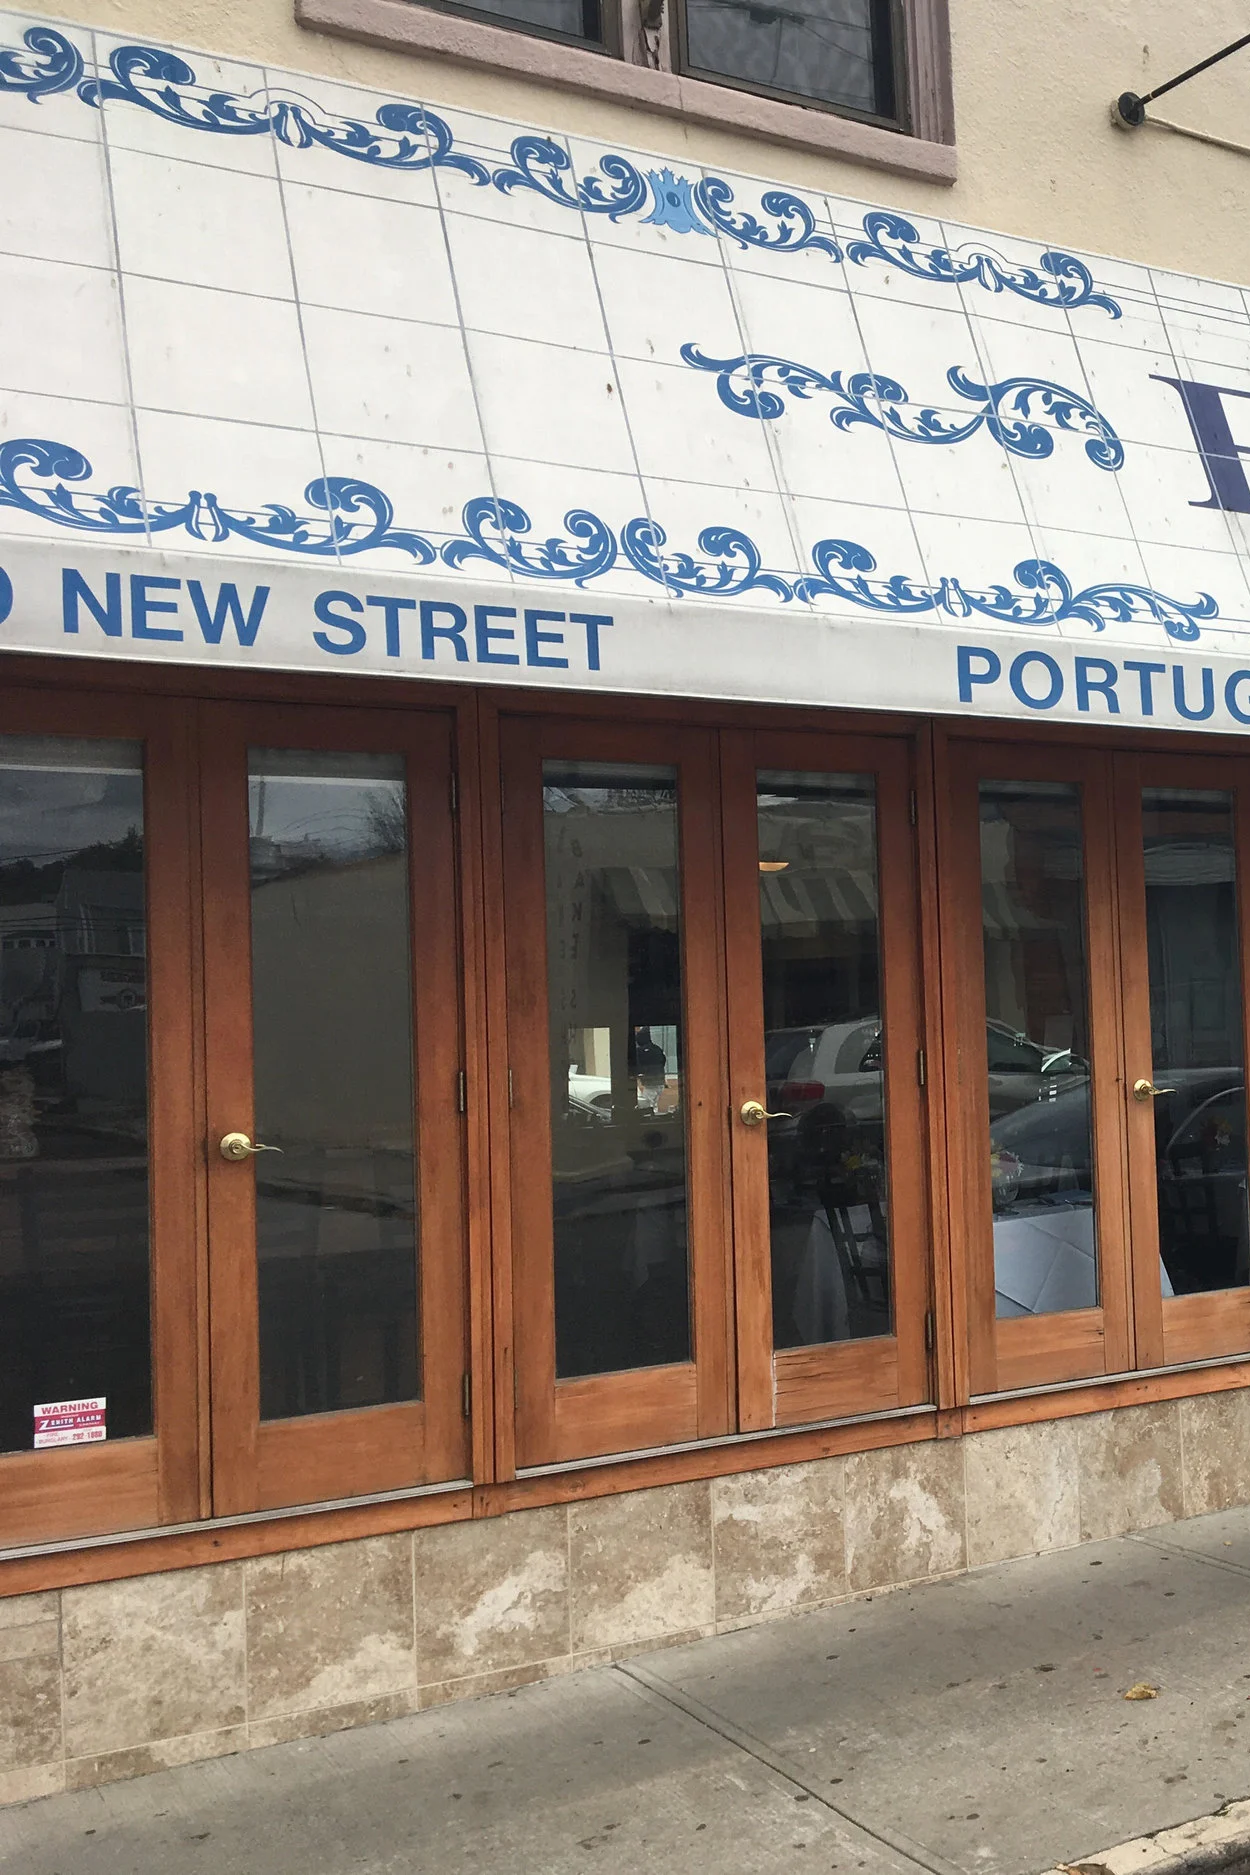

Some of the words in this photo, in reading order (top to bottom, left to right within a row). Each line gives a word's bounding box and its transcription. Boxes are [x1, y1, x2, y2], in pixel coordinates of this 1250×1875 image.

[62, 568, 270, 647] NEW
[313, 590, 614, 671] STREET
[41, 1401, 98, 1414] WARNING
[39, 1418, 74, 1431] ZENITH
[76, 1415, 102, 1423] ALARM
